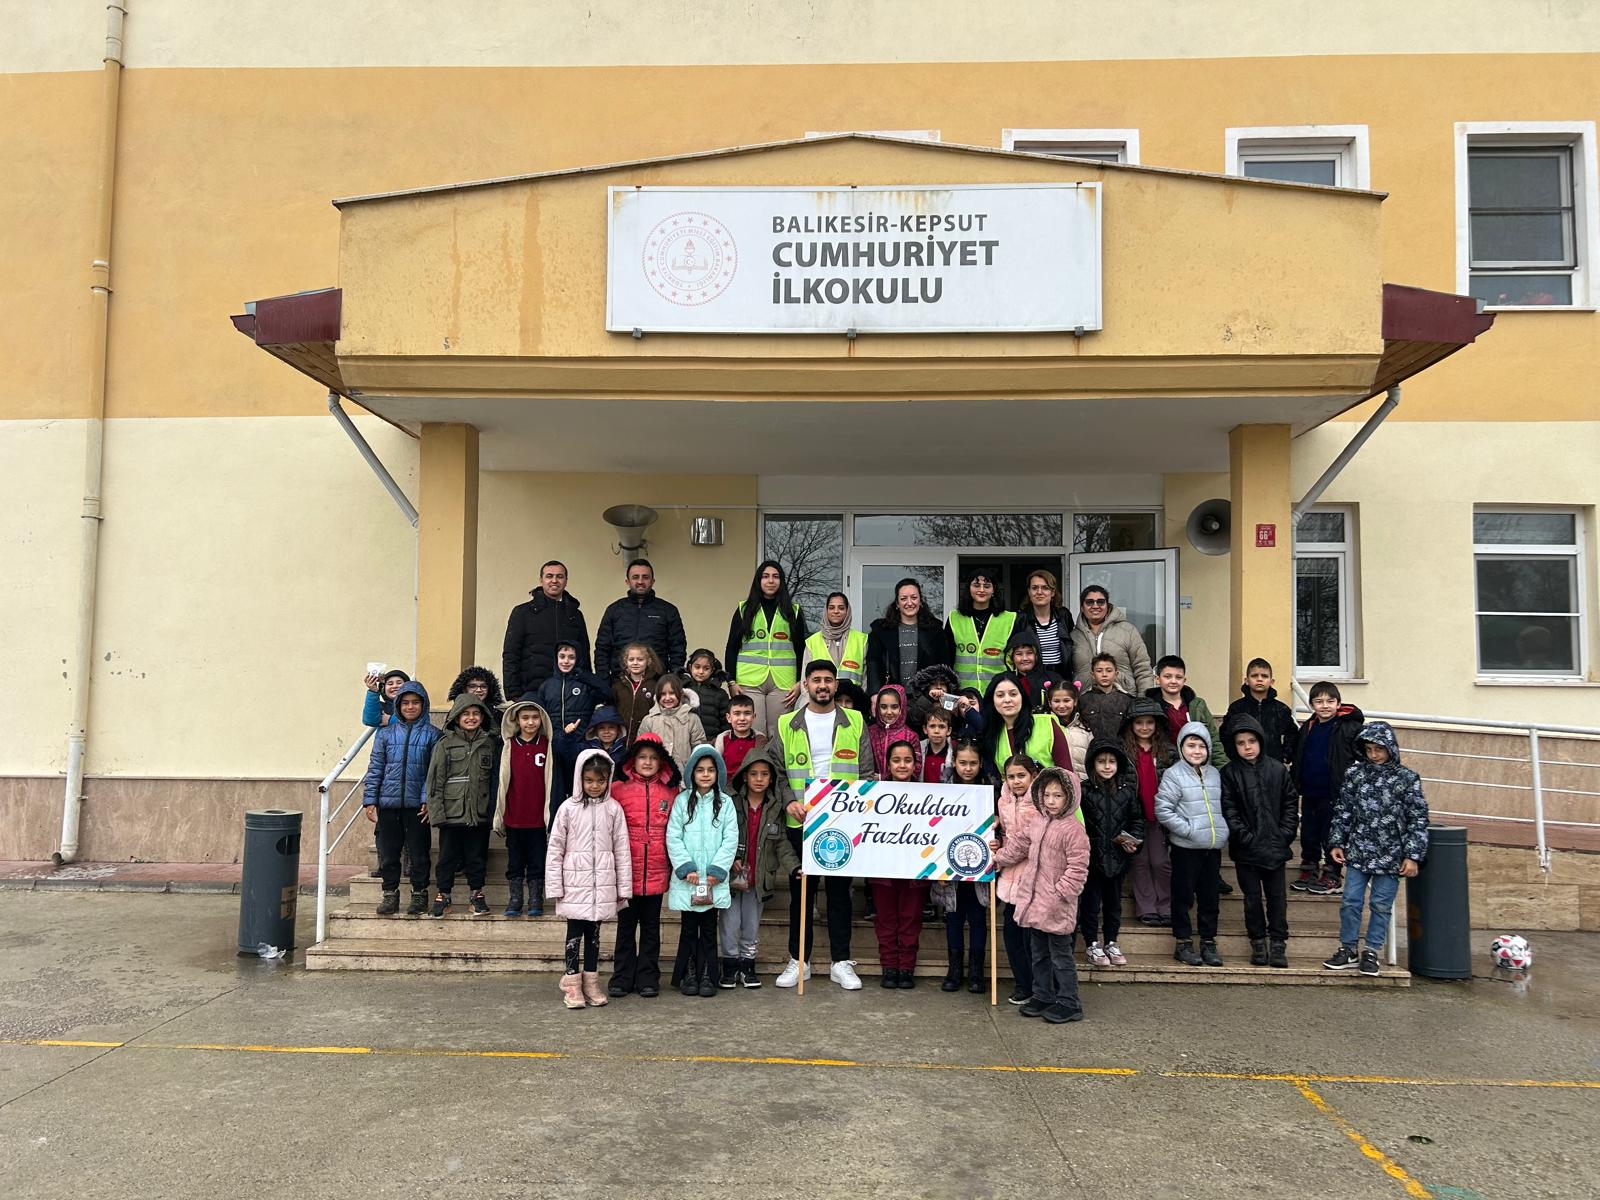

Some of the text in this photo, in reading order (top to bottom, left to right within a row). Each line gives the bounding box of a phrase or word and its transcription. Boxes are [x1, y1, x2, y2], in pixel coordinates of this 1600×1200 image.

[772, 212, 987, 234] BALIKESİR-KEPSUT
[772, 235, 999, 268] CUMHURİYET
[773, 272, 943, 304] İLKOKULU
[1259, 530, 1268, 540] 66
[535, 753, 546, 766] C
[830, 791, 970, 817] Bir Okuldan
[861, 822, 939, 846] Fazlası
